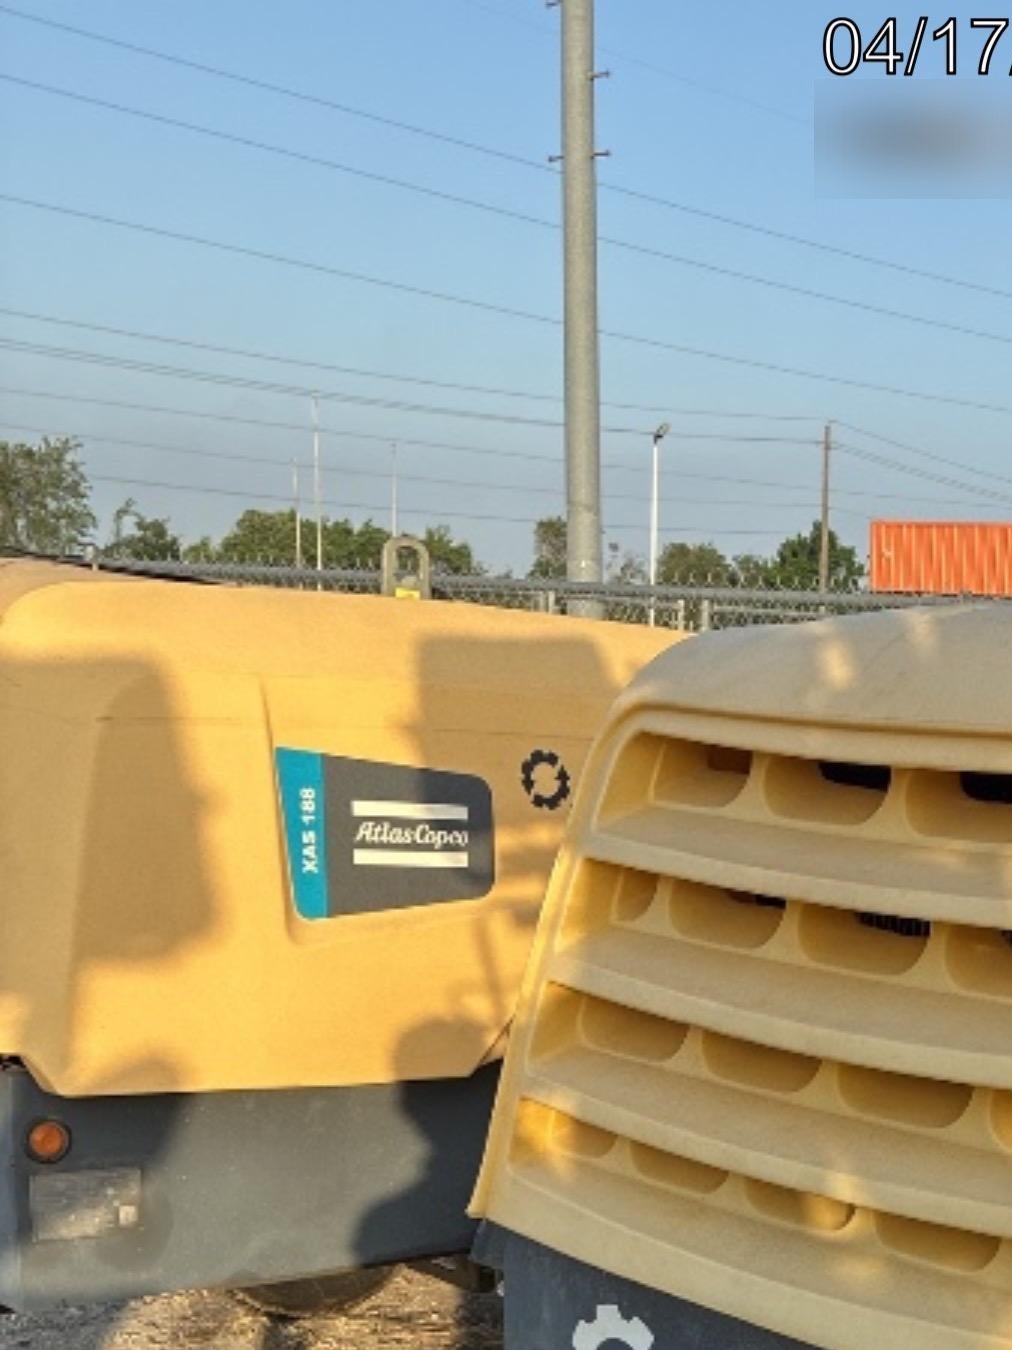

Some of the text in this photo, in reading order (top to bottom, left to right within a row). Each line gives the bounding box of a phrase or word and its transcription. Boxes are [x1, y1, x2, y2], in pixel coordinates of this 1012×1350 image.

[299, 787, 319, 874] XAS 188
[354, 820, 468, 850] Atlas Copco
